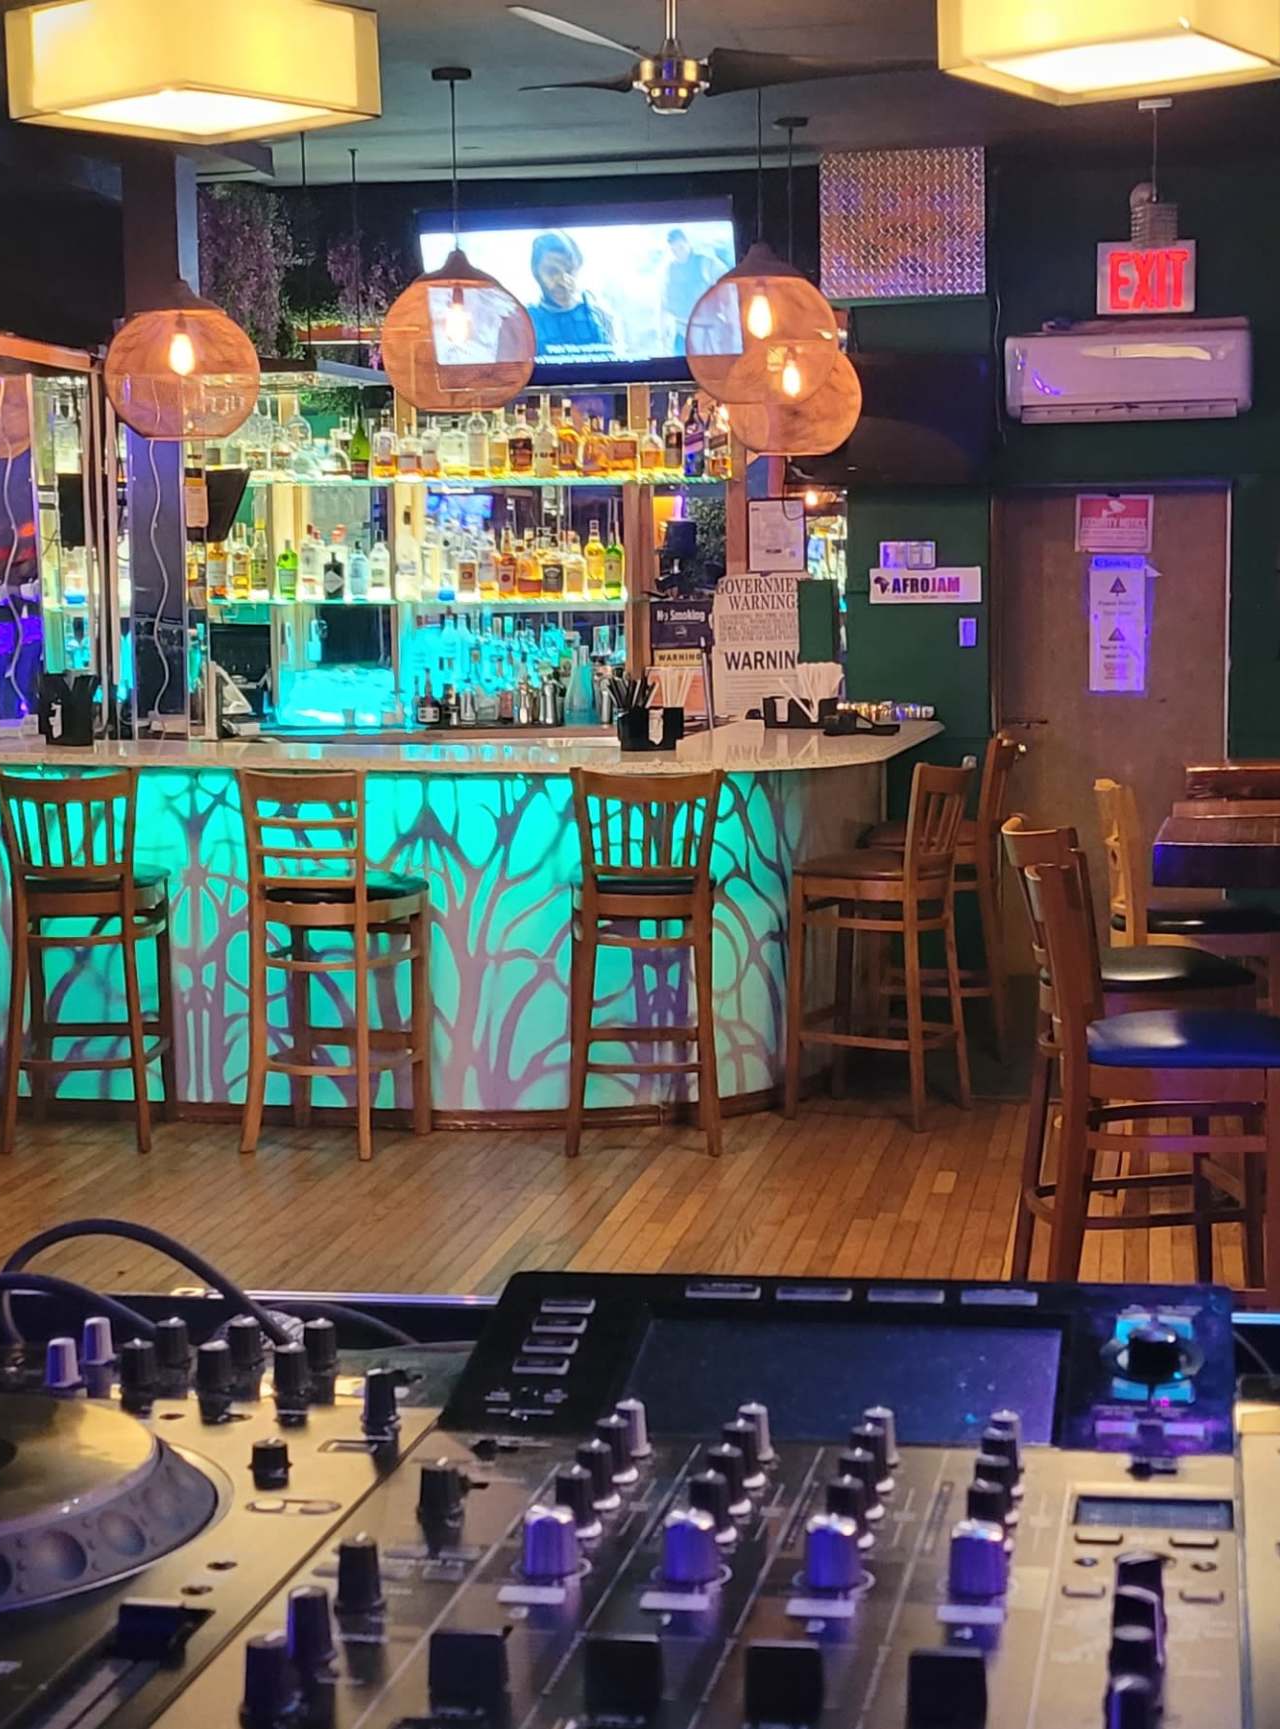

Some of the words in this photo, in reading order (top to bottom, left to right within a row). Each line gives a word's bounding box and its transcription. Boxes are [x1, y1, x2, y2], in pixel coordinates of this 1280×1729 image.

[1108, 249, 1189, 310] EXIT
[715, 577, 801, 595] GOVERNME
[892, 576, 960, 594] AFROJAM
[728, 594, 796, 612] WARNING
[670, 608, 706, 622] Smoking
[658, 653, 702, 662] WARNING
[724, 649, 797, 671] WARNIN
